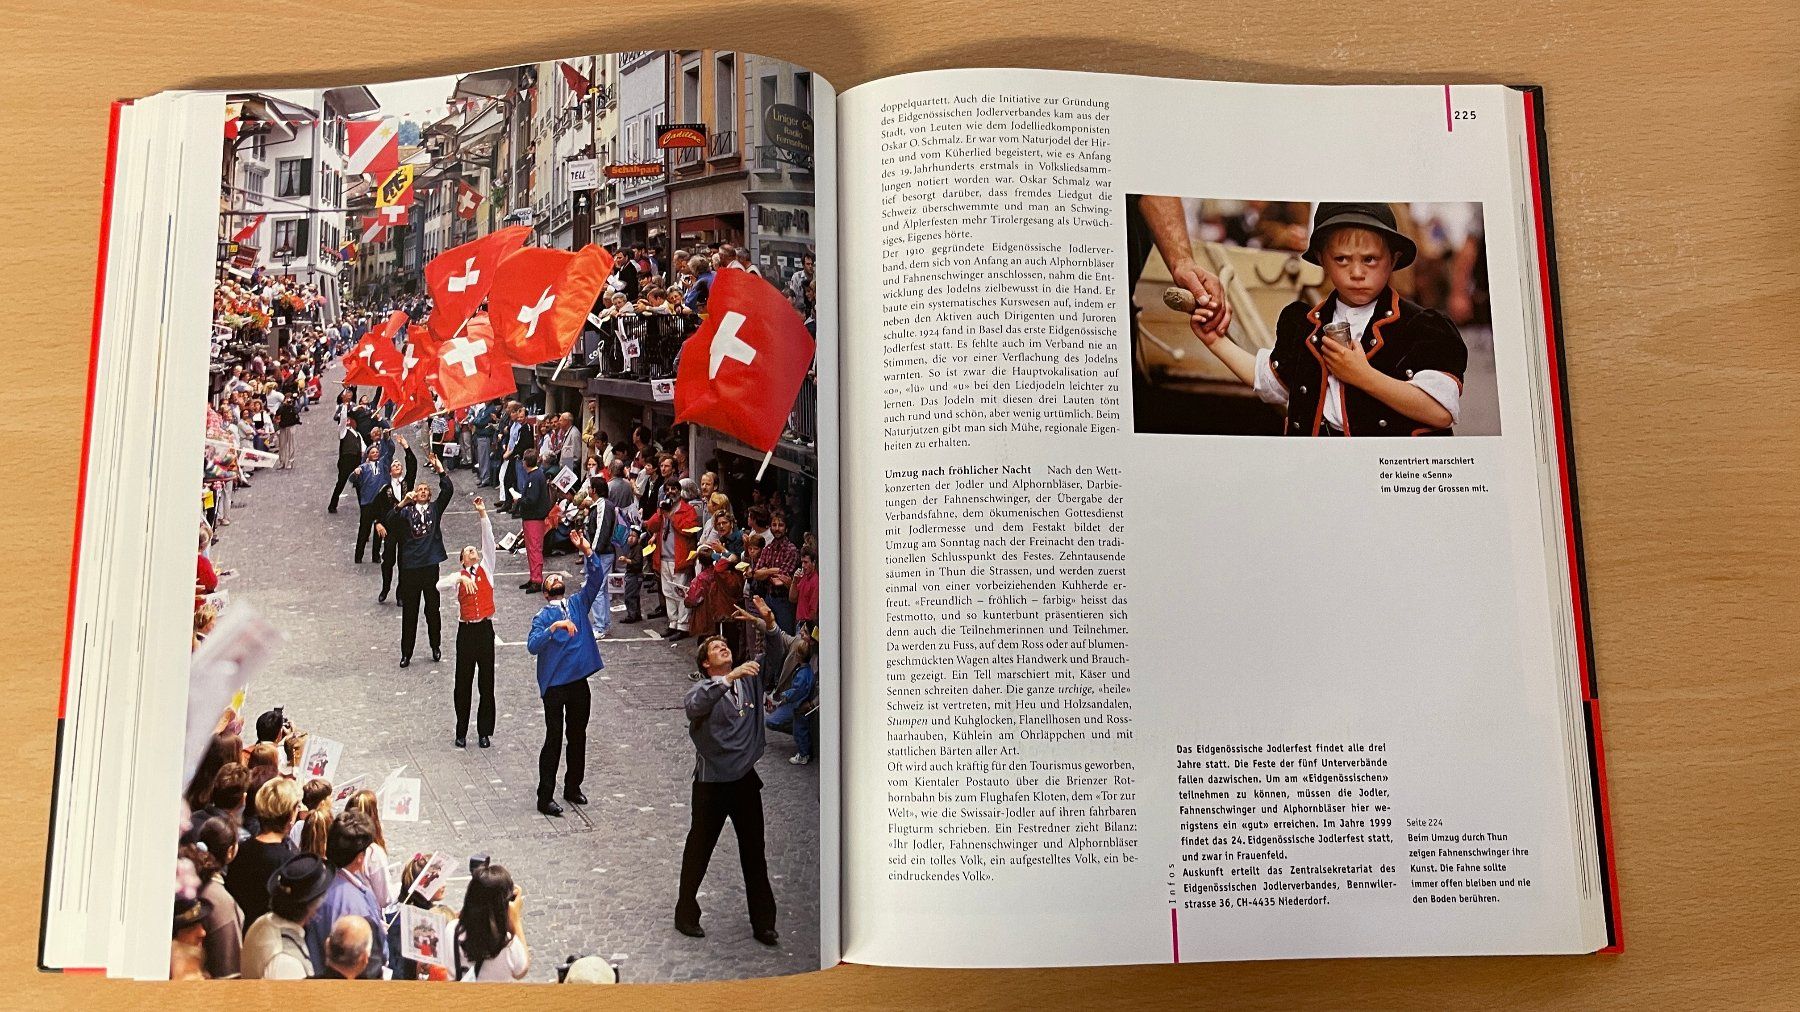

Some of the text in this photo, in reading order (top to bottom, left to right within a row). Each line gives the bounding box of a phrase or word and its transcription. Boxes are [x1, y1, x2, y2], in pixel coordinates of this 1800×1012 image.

[880, 97, 950, 113] doppelquartett.
[953, 94, 977, 104] Auch
[981, 94, 996, 103] die
[999, 94, 1041, 104] Initiative
[1062, 96, 1110, 111] Gründung
[1454, 110, 1477, 120] 225
[662, 130, 702, 145] Cadillac
[571, 170, 586, 180] TELL
[882, 205, 917, 218] Schweiz
[922, 202, 999, 214] überschwemmte
[1004, 201, 1023, 211] und
[1071, 203, 1112, 217] Schwing-
[882, 304, 908, 314] baute
[910, 301, 925, 310] ein
[928, 296, 997, 311] systematisches
[1000, 297, 1050, 307] Kurswesen
[1053, 297, 1072, 308] auf,
[1074, 298, 1104, 309] indem
[884, 437, 970, 451] heiten zu erhalten.
[1379, 457, 1474, 465] Konzentriert marschiert
[885, 464, 1122, 480] Umzug nach fröhlicher Nacht Nach den Wett-
[1380, 471, 1453, 479] der kleine «Senn»
[1381, 484, 1488, 495] im Umzug der Grossen mit.
[886, 609, 1128, 622] Festmotto, und so kunterbunt präsentieren sich
[887, 745, 1020, 756] stattlichen Bärten aller Art.
[1176, 743, 1386, 756] Das Eidgenössische Jodlerfest findet alle drei
[1177, 757, 1387, 769] Jahre statt. Die Feste der fünf Unterverbände
[1178, 772, 1388, 785] fallen dazwischen. Um am «Eidgenössischen»
[1179, 788, 1389, 800] teilnehmen zu können, müssen die Jodler,
[1180, 805, 1256, 816] Fahnenschwinger
[1261, 804, 1278, 814] und
[1283, 803, 1346, 815] Alphornbläser
[1351, 803, 1369, 812] hier
[888, 821, 1137, 836] Flugturm schrieben. Ein Festredner zieht Bilanz:
[1181, 818, 1392, 833] nigstens ein «gut» erreichen. Im Jahre 1999
[1407, 818, 1443, 827] Seite 224
[1181, 833, 1393, 846] findet das 24. Eidgenössische Jodlerfest statt,
[1408, 832, 1508, 843] Beim Umzug durch Thun
[1182, 850, 1287, 862] und zwar in Frauenfeld.
[1409, 847, 1529, 859] zeigen Fahnenschwinger ihre
[1183, 863, 1396, 877] Auskunft erteilt das Zentralsekretariat des
[1410, 863, 1506, 873] Kunst. Die Fahne sollte
[888, 870, 994, 881] eindruckendes Volk».
[1167, 863, 1176, 904] Infos
[1184, 879, 1397, 895] Eidgenössischen Jodlerverbandes, Bennwiler-
[1411, 878, 1531, 888] immer offen bleiben und nie
[1184, 895, 1330, 909] strasse 36, CH-4435 Niederdorf.
[1412, 894, 1500, 904] den Boden berühren.
